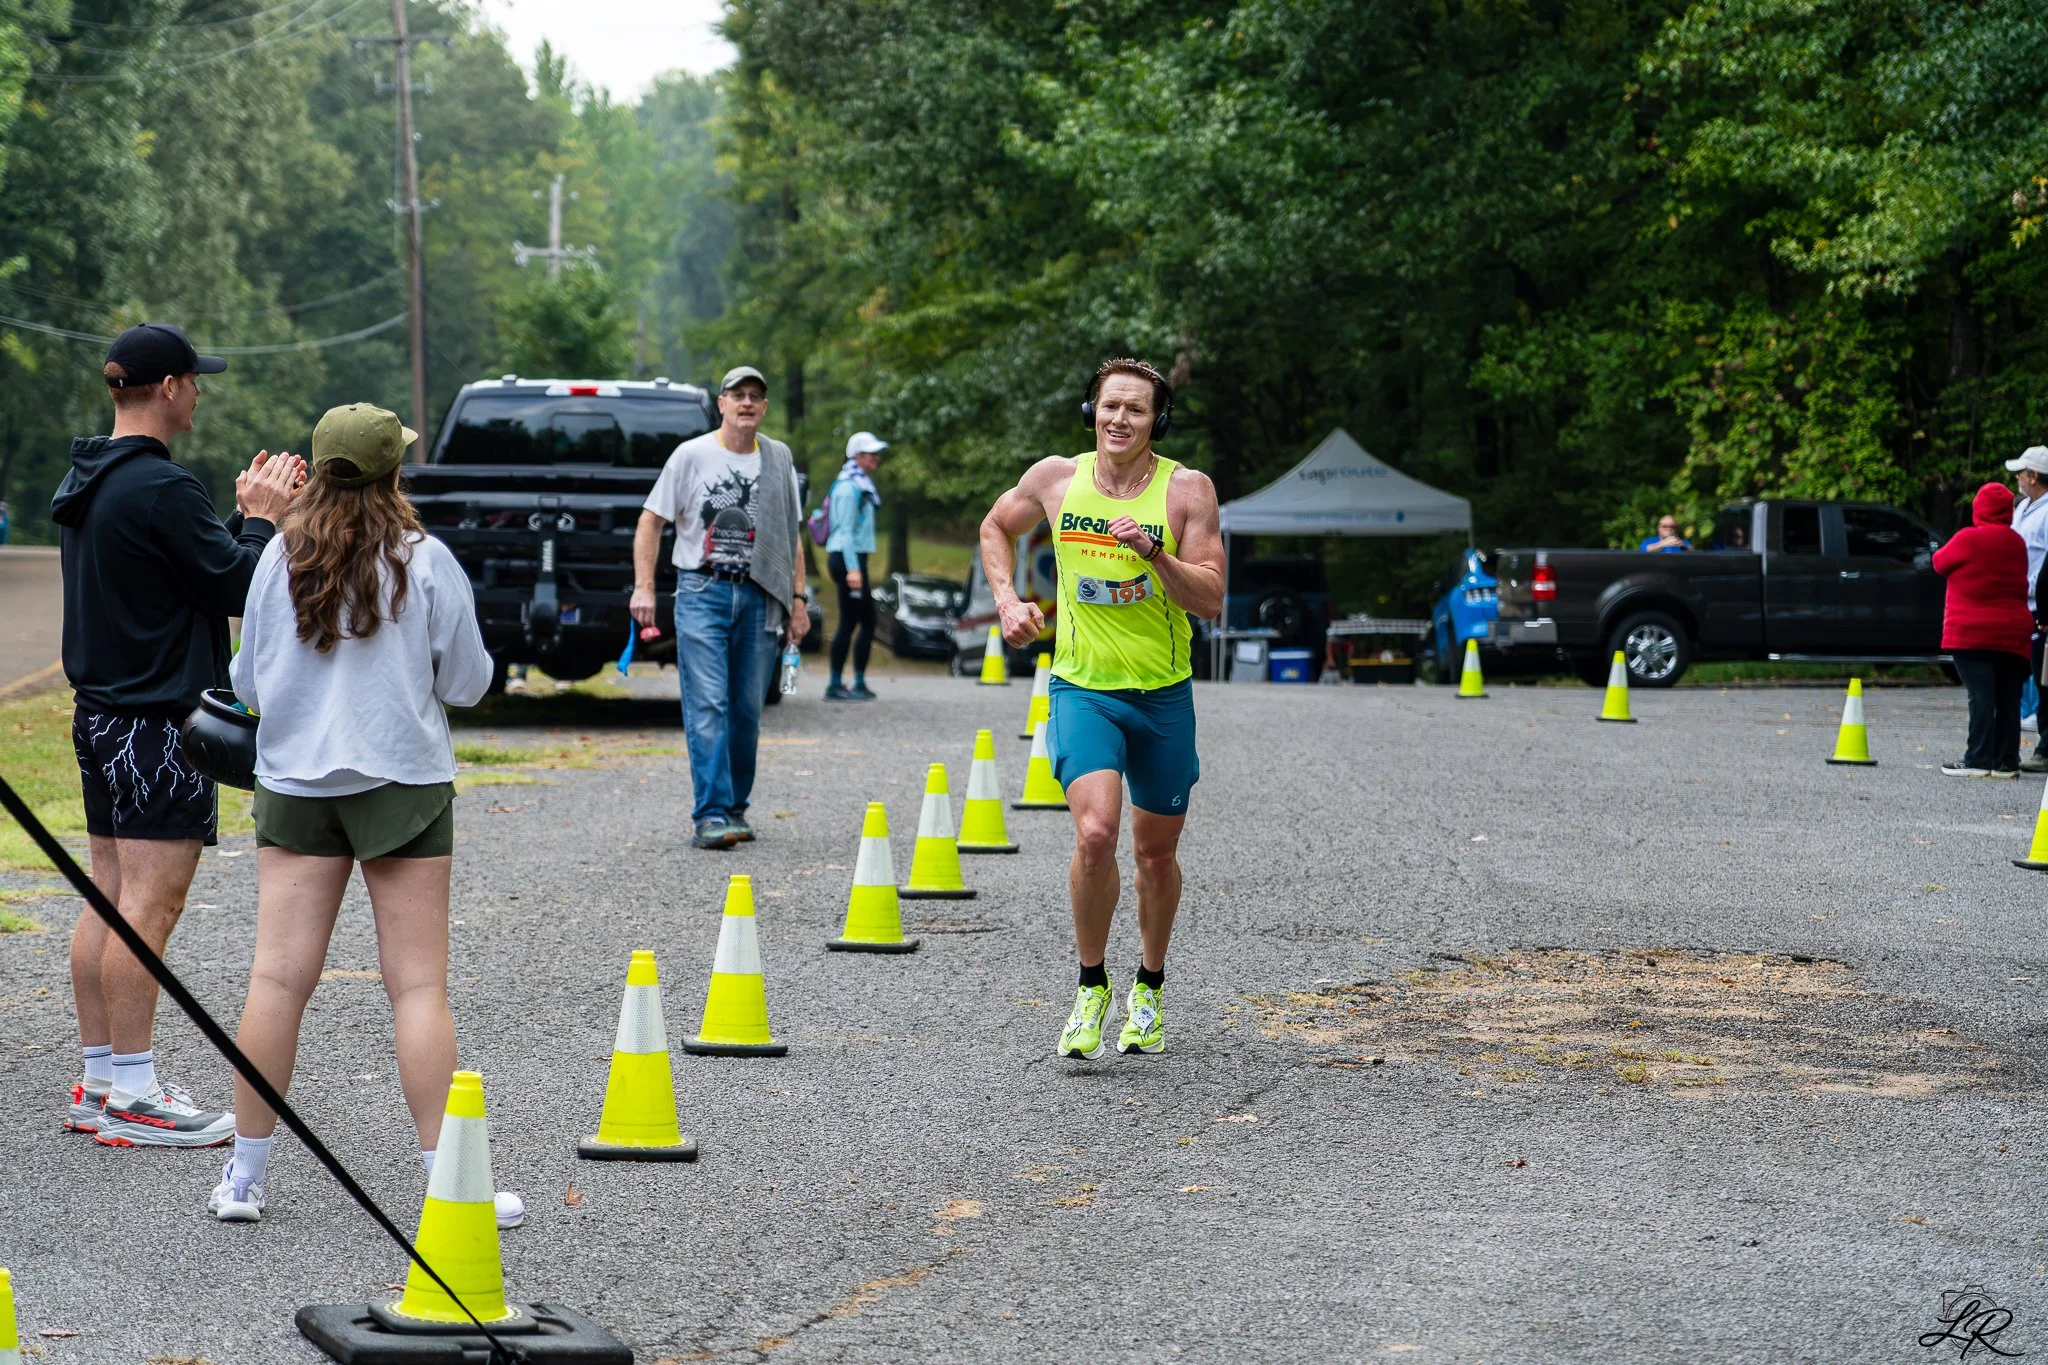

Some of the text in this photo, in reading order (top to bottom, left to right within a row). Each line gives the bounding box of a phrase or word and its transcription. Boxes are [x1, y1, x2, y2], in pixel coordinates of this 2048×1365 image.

[1081, 549, 1137, 562] MEMPHIS
[1109, 583, 1146, 604] 195
[111, 1111, 177, 1129] ALTRA
